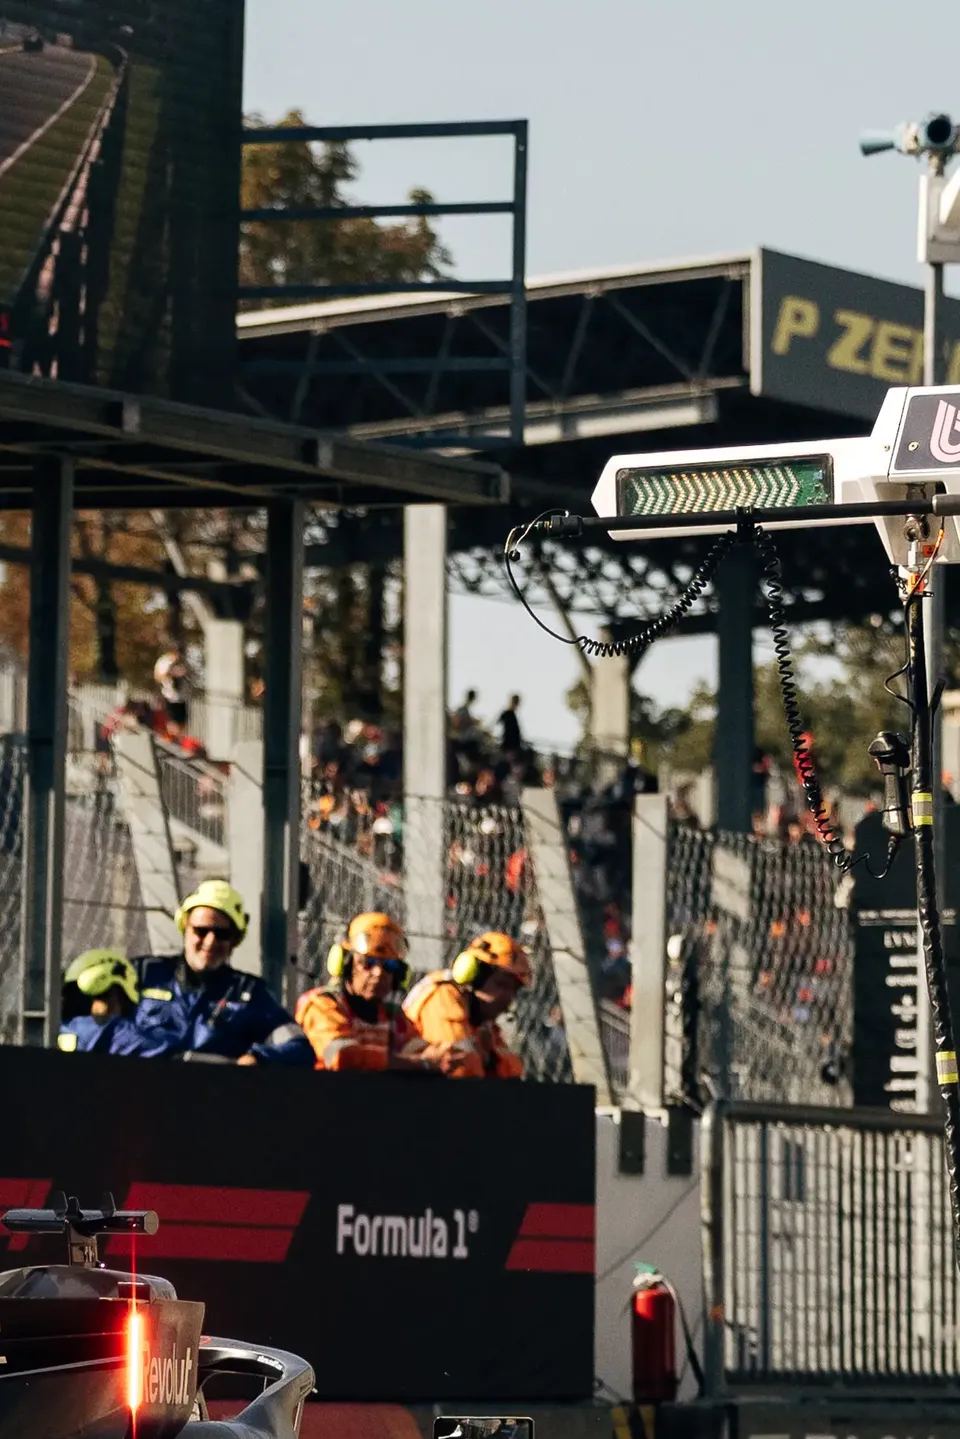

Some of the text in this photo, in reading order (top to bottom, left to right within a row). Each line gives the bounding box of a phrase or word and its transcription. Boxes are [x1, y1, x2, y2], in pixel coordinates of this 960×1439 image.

[771, 295, 820, 356] P
[336, 1204, 448, 1258] Formula
[143, 1342, 193, 1405] Revolut
